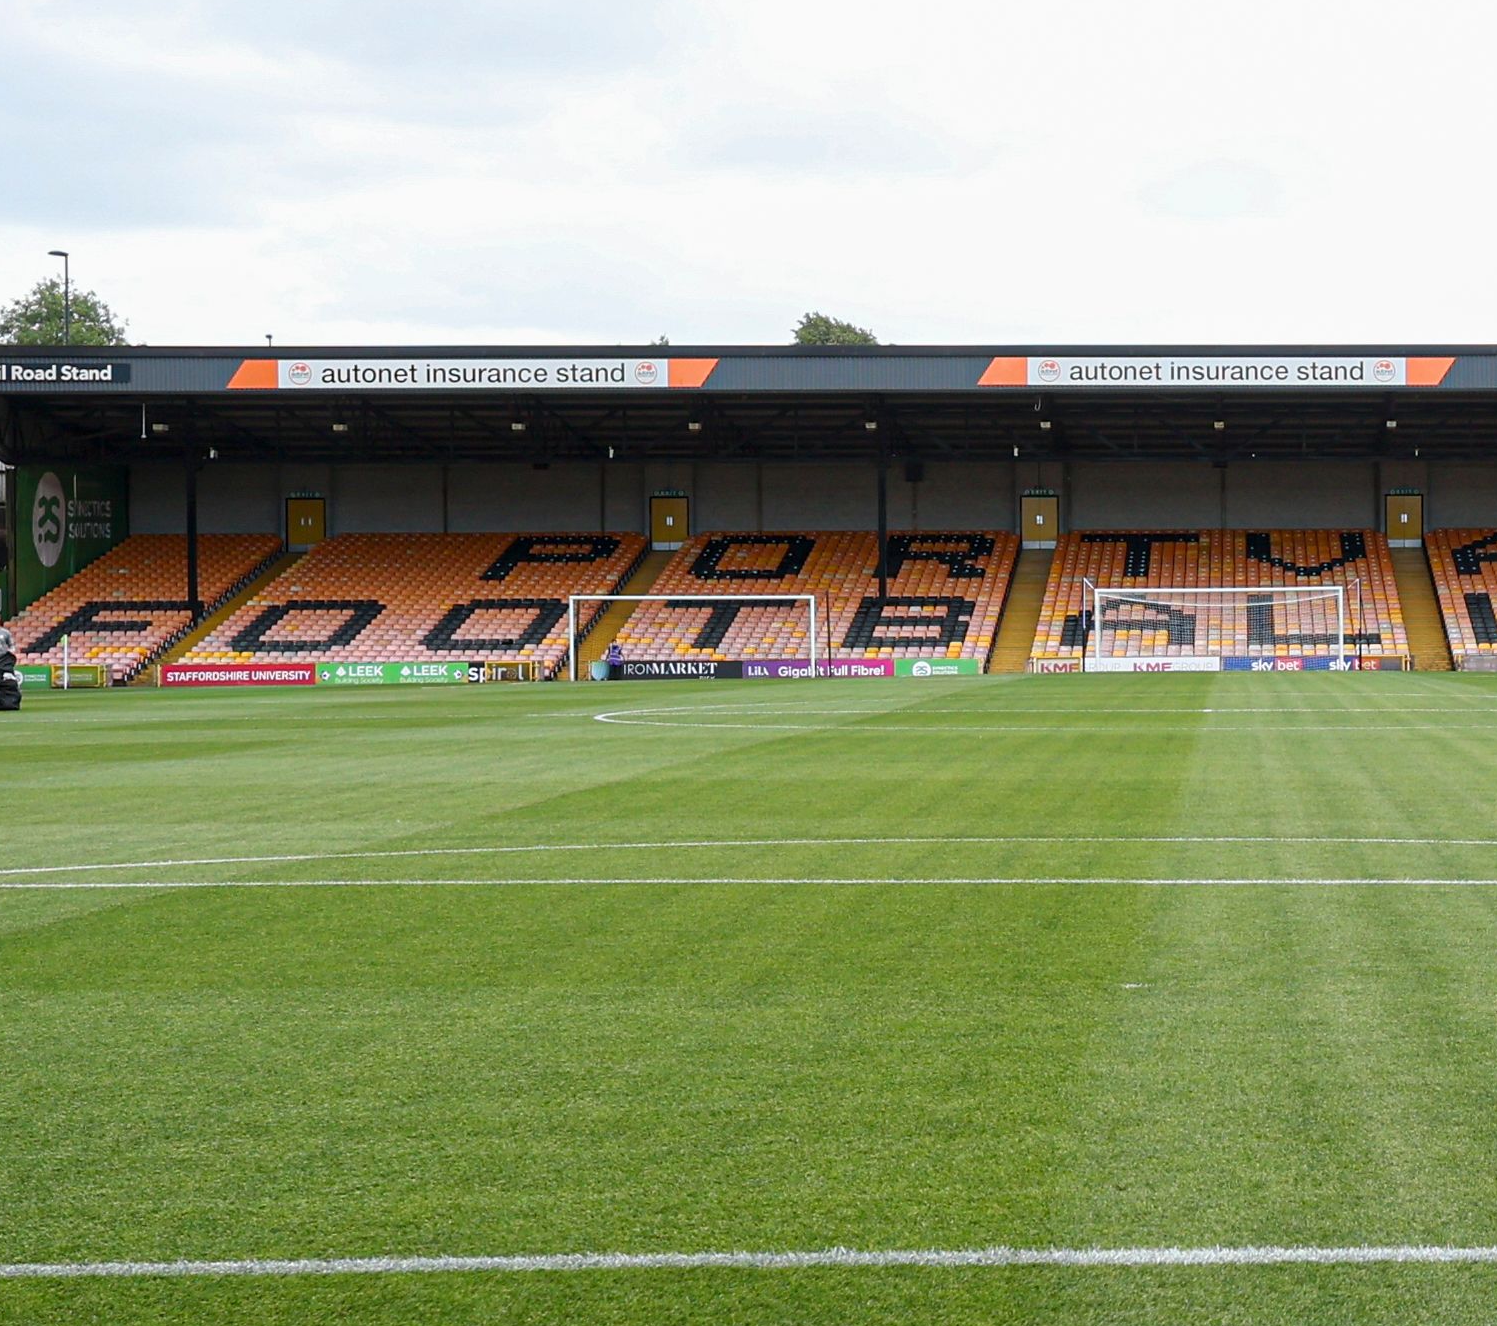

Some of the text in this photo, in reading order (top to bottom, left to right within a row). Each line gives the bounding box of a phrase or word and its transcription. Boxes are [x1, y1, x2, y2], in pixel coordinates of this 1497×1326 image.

[10, 364, 56, 381] Road
[60, 364, 112, 381] Stand
[322, 363, 626, 384] autonet insurance stand
[1070, 361, 1364, 381] autonet insurance stand
[348, 665, 383, 677] LEEK
[413, 665, 448, 677] LEEK
[623, 662, 717, 675] IRONMARKET
[851, 663, 884, 676] Fibre!
[1040, 662, 1081, 673] KME
[1133, 661, 1172, 672] KME
[1251, 659, 1300, 673] sky bet
[1329, 659, 1351, 672] sky
[167, 669, 311, 682] STAFFORDSHIRE UNIVERSITY
